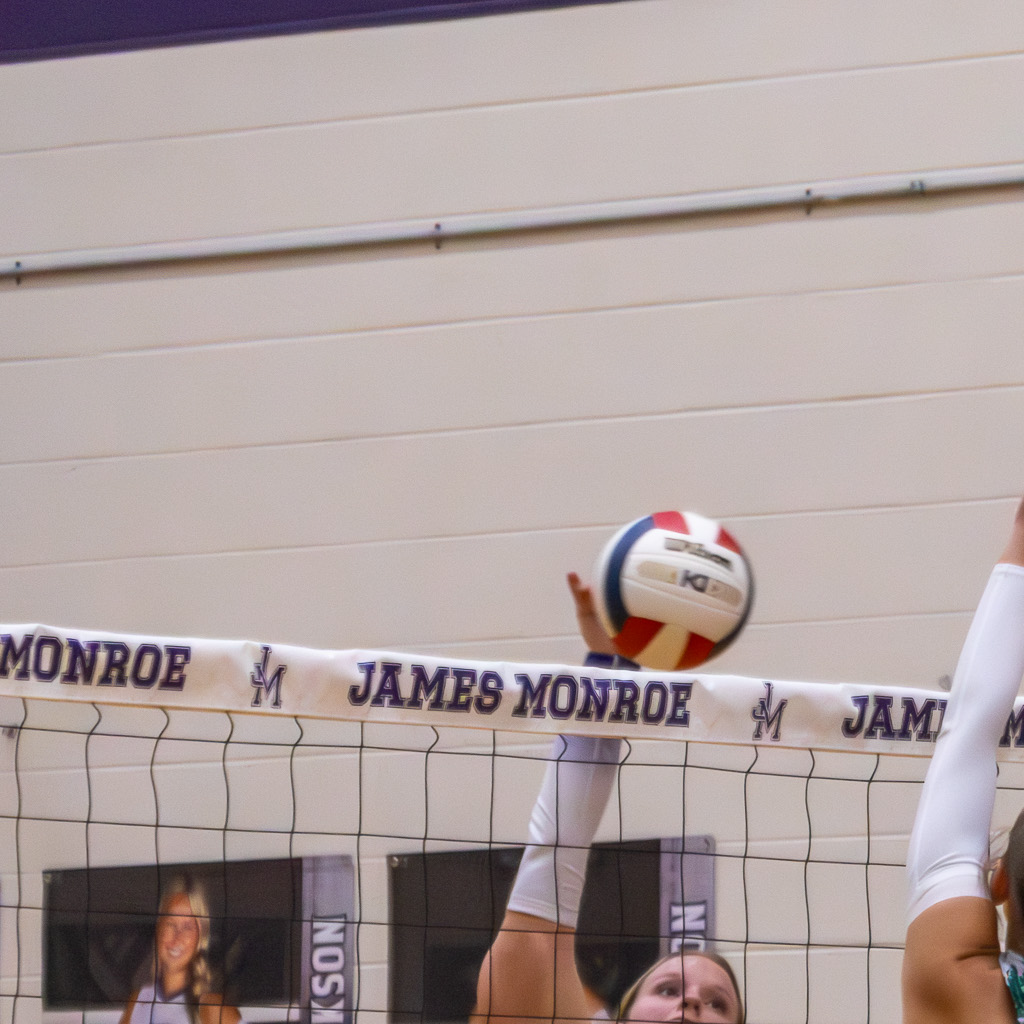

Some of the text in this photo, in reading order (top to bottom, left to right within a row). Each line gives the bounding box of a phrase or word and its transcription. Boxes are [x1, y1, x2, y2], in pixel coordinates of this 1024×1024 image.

[0, 634, 191, 690] MONROE
[349, 661, 693, 727] JAMES MONROE
[841, 695, 948, 742] JAM
